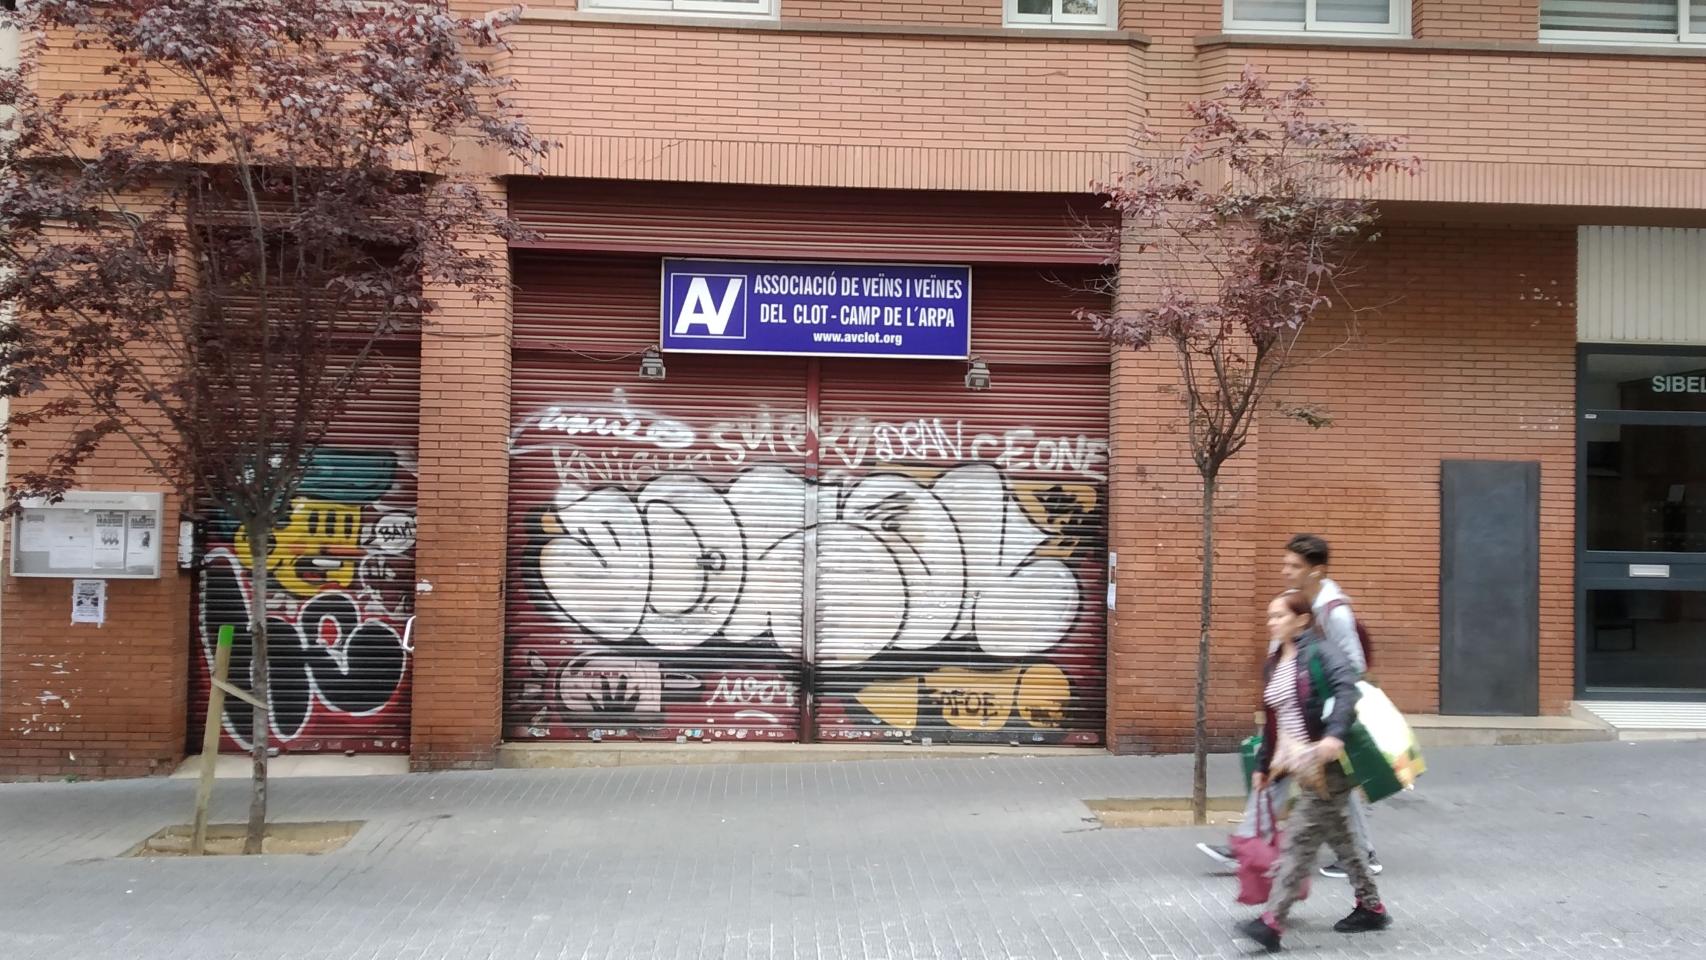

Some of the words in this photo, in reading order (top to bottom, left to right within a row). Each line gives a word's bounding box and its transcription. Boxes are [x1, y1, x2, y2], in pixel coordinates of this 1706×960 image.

[754, 271, 837, 296] ASSOCIACIÓ
[841, 277, 860, 296] DE
[862, 273, 903, 298] VEÏNS
[906, 278, 911, 298] I
[914, 274, 963, 299] VEÏNES
[674, 277, 743, 335] AV
[760, 303, 787, 323] DEL
[793, 304, 829, 325] CLOT
[840, 305, 881, 326] CAMP
[884, 306, 903, 327] DE
[813, 332, 903, 346] www.avclot.org
